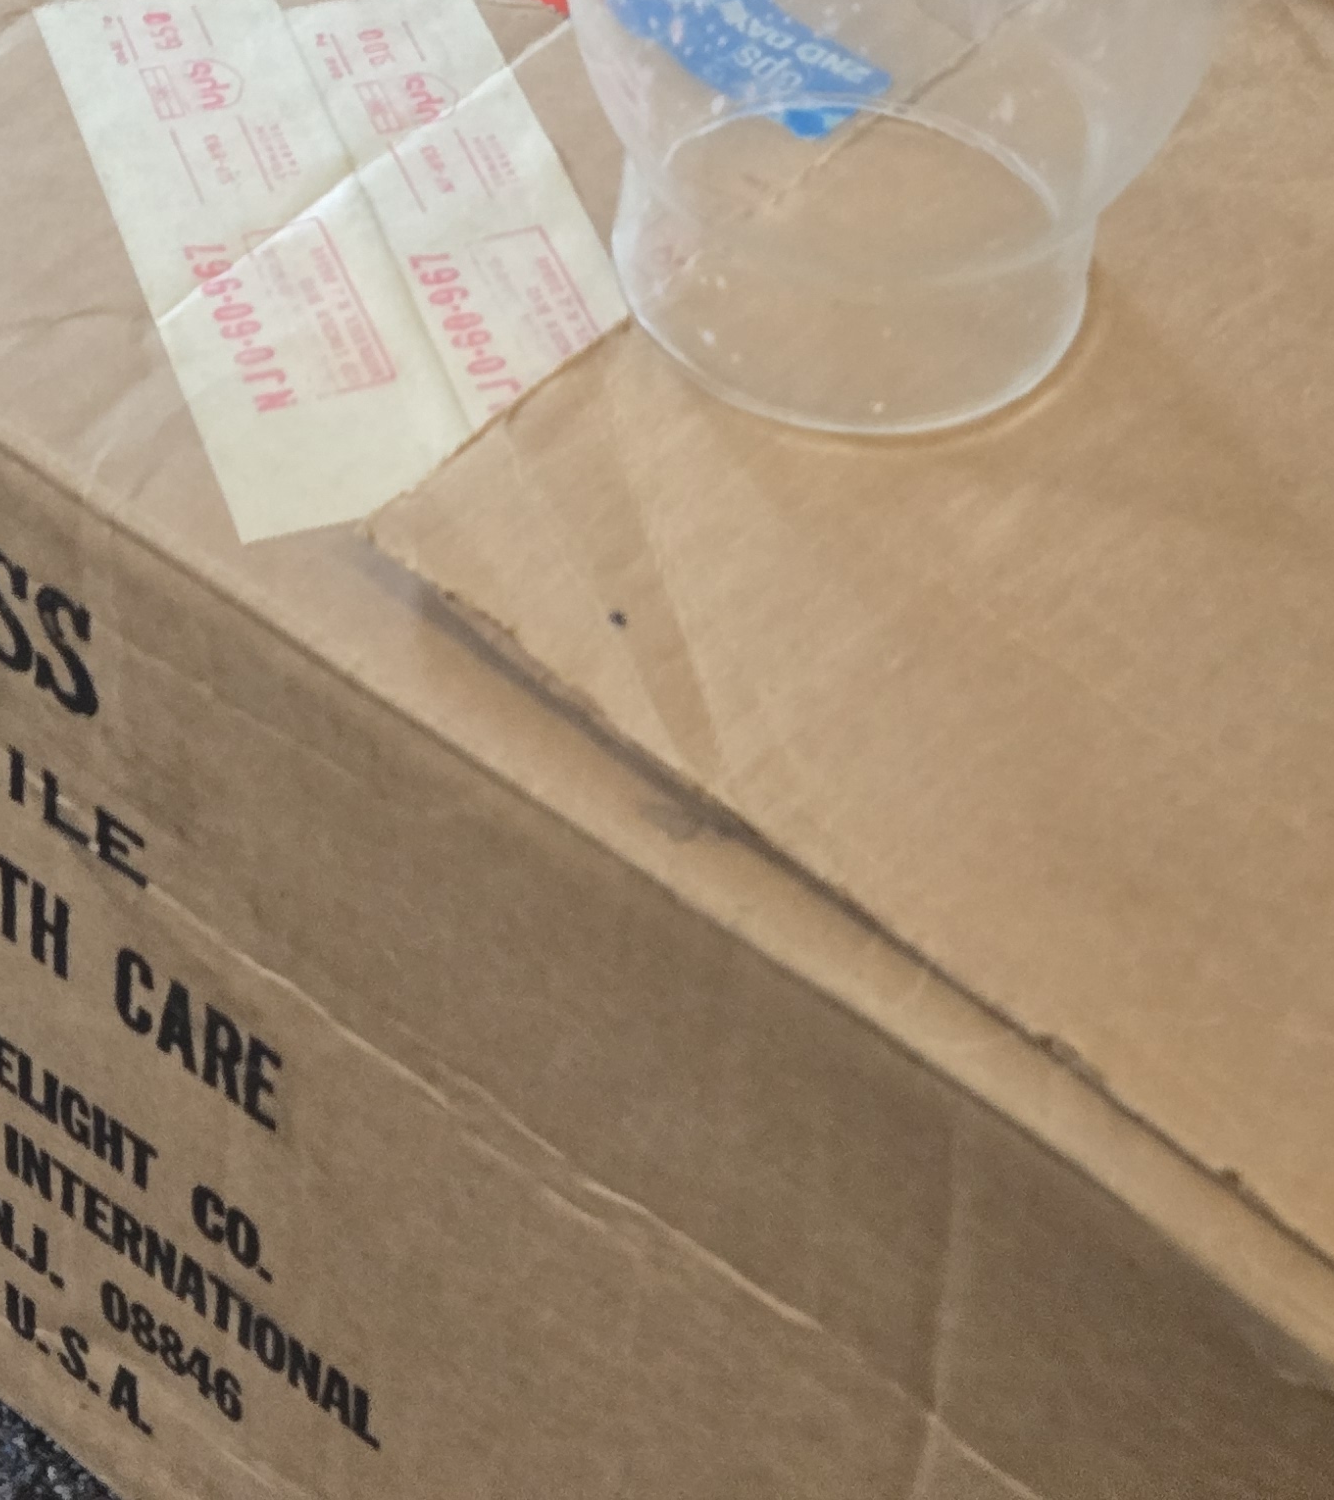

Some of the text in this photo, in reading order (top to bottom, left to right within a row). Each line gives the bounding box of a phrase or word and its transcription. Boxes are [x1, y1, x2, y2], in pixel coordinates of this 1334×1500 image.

[114, 946, 283, 1131] CARE
[4, 1123, 381, 1451] INTERNATIONAL
[191, 1184, 273, 1283] CO.
[100, 1279, 244, 1423] 08846
